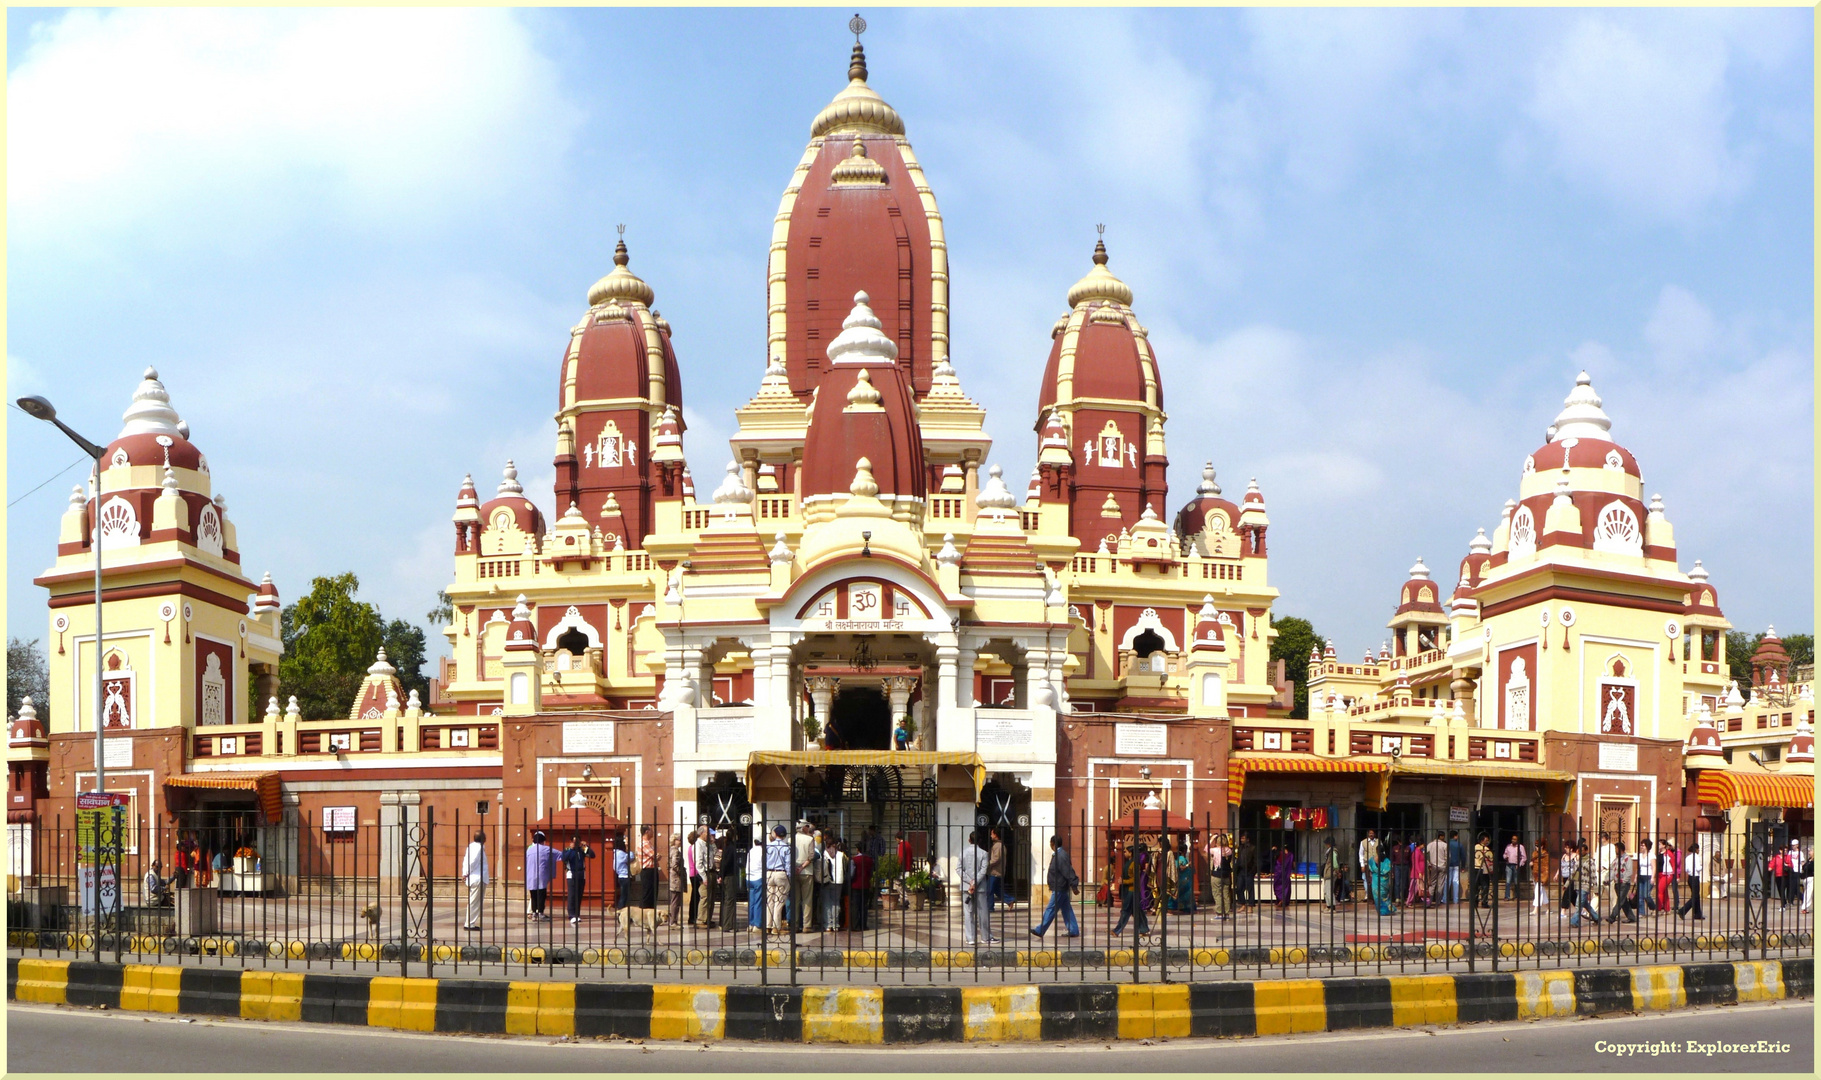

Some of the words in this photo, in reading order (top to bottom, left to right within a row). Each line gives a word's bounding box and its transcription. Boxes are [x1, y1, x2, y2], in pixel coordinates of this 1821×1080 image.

[825, 620, 833, 630] श्री
[835, 619, 880, 630] लक्ष्मीनारायण
[883, 620, 904, 630] मन्दिर
